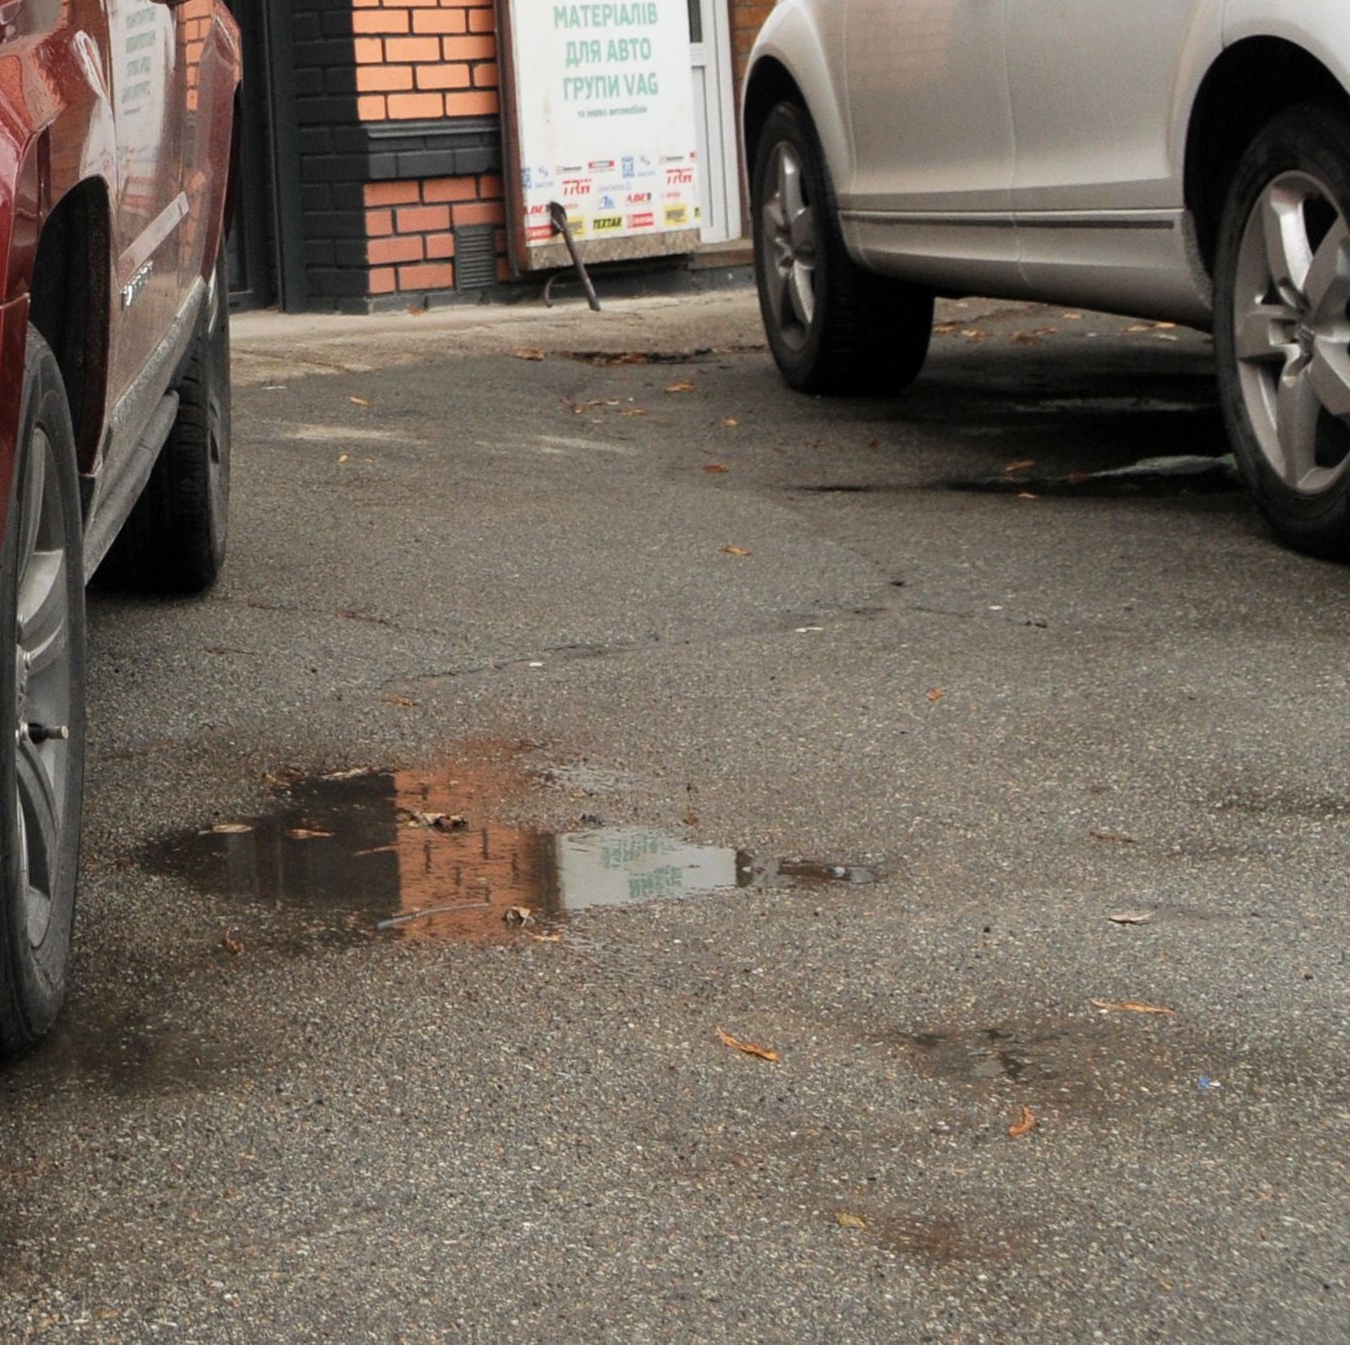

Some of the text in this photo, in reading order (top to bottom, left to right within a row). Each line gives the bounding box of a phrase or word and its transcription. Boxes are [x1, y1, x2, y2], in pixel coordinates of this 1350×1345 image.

[553, 2, 658, 29] МАТЕРІАЛІВ
[565, 37, 651, 68] ДЛЯ АВТО
[563, 72, 658, 101] ГРУПИ VAG
[592, 216, 622, 230] TEXTAR
